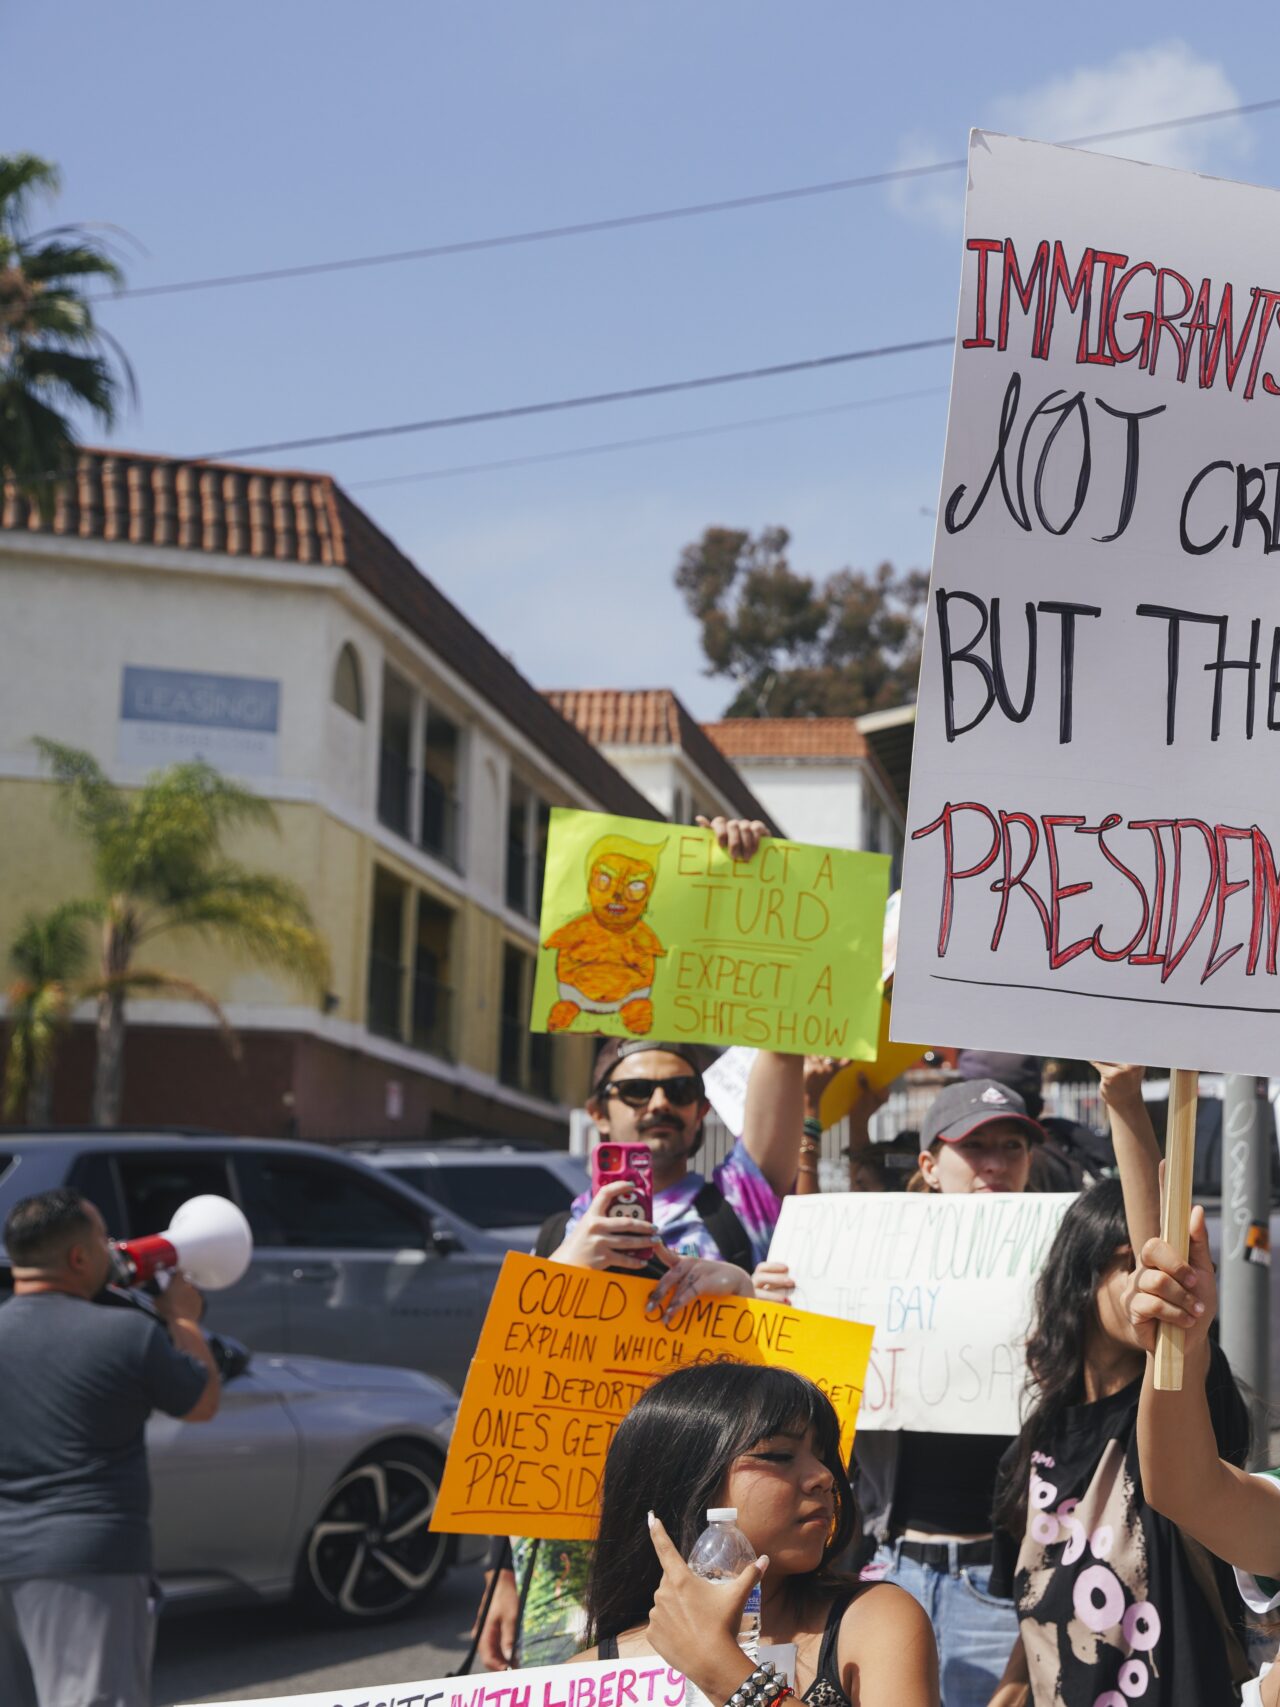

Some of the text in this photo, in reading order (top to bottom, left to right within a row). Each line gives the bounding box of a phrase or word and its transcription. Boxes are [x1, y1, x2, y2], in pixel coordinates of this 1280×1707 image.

[945, 371, 1167, 543] NOT
[935, 587, 1102, 745] BUT
[677, 836, 834, 891] ELECT A
[692, 883, 831, 943] TURD
[676, 951, 833, 1006] EXPECT A
[673, 995, 850, 1048] SHITSHOW
[518, 1268, 627, 1321] COULD
[886, 1286, 940, 1334] BAY
[504, 1321, 597, 1363] EXPLAIN
[613, 1334, 682, 1365] WHICH
[492, 1362, 531, 1398] YOU
[918, 1343, 1016, 1406] USA
[472, 1407, 552, 1452] ONES
[543, 1667, 687, 1707] LIBERTY
